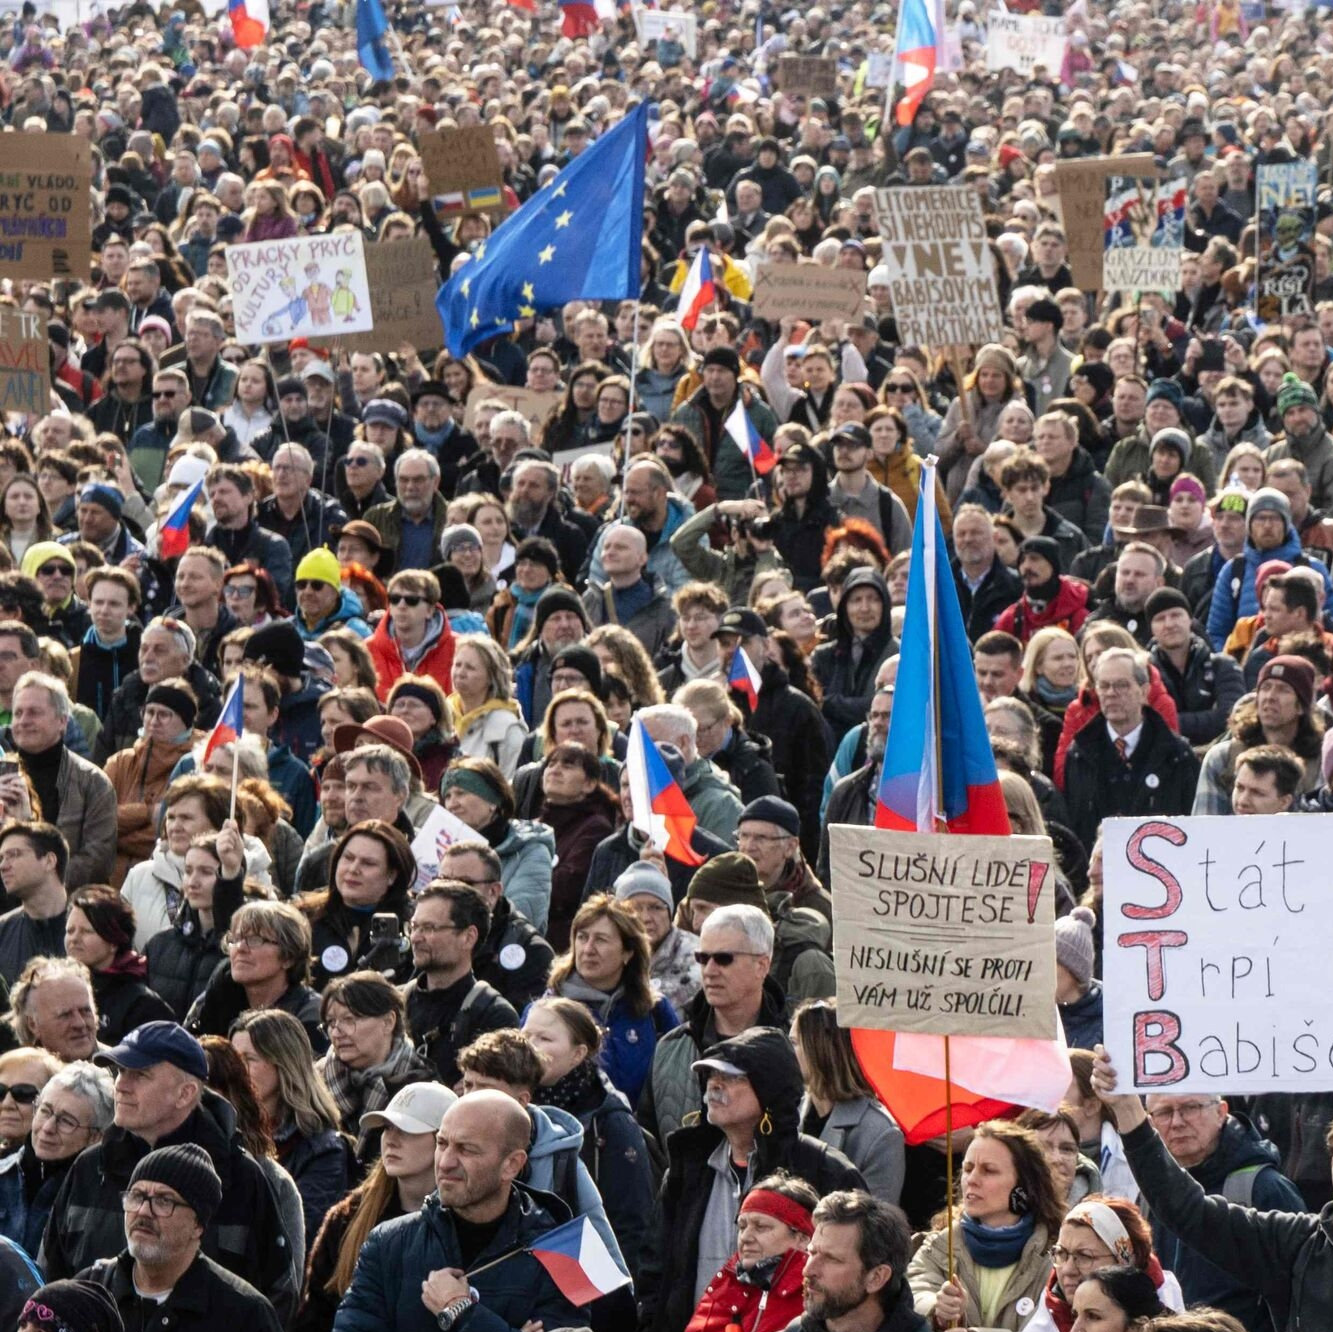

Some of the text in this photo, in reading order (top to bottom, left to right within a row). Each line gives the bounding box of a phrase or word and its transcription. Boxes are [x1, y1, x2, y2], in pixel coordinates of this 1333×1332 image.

[48, 195, 73, 212] OD
[229, 235, 356, 272] PRACKY PRYČ
[232, 271, 251, 294] OD
[237, 262, 291, 333] KULTURY
[858, 849, 1031, 888] SLUŠNÍ LIDÉ
[850, 945, 1034, 982] NESLUŠNÍ SE PROTI
[1117, 930, 1281, 1002] Trpí
[853, 981, 1027, 1018] VÁM UŽ SPOLČILI.
